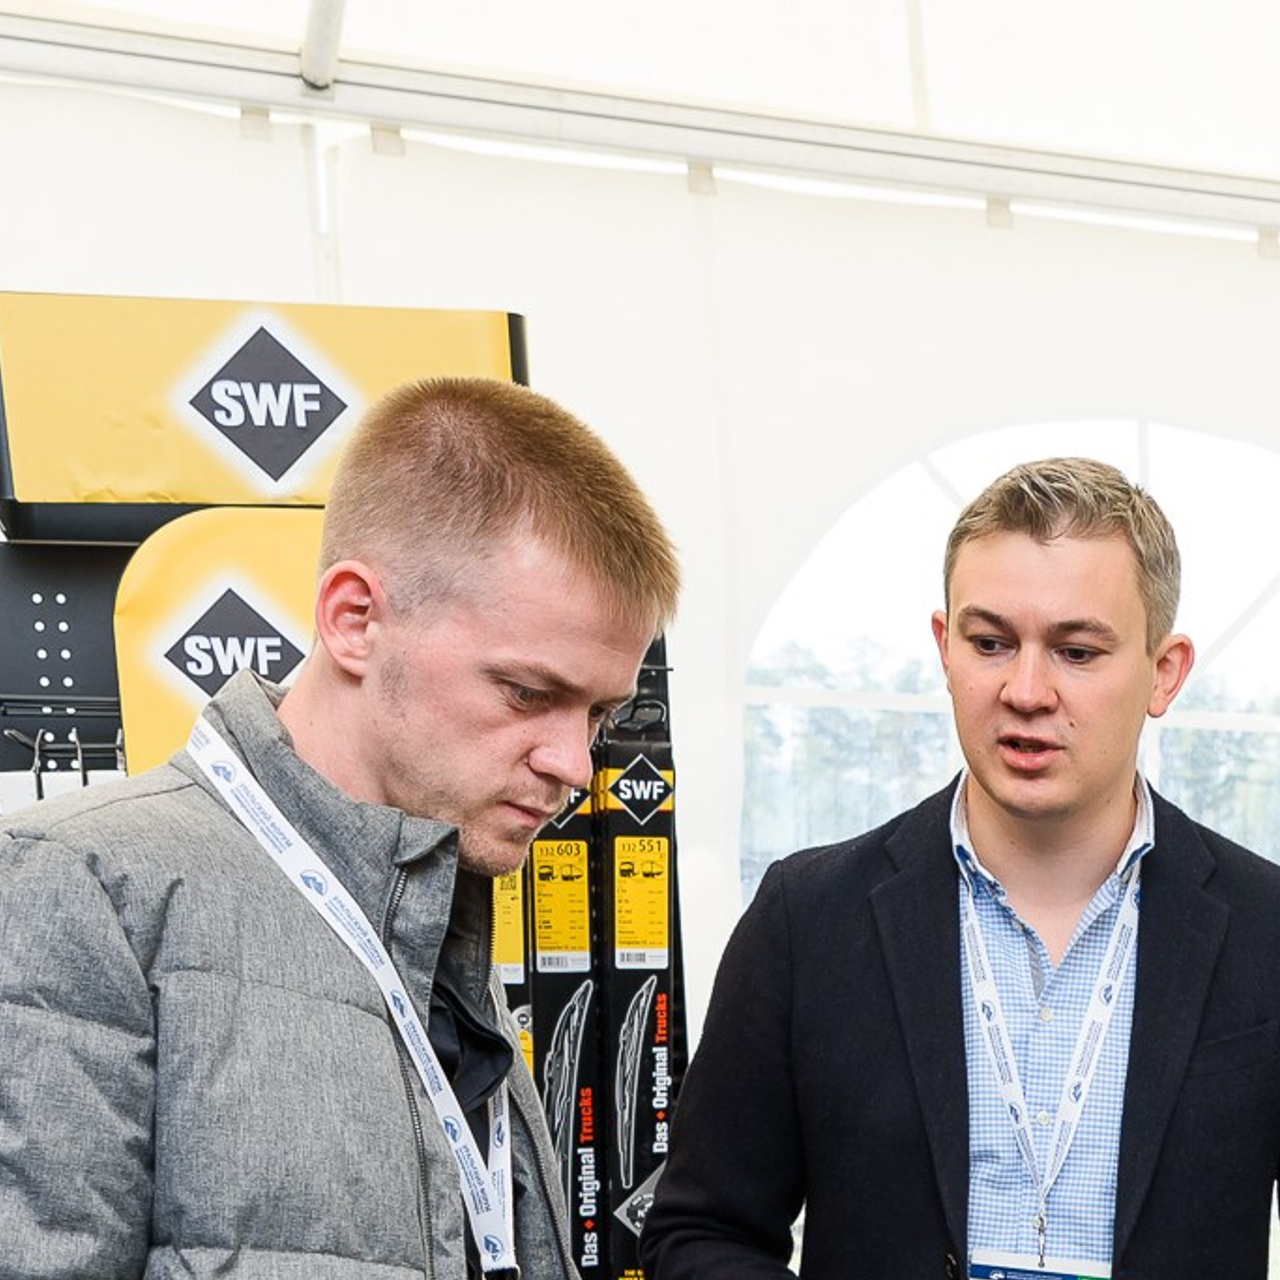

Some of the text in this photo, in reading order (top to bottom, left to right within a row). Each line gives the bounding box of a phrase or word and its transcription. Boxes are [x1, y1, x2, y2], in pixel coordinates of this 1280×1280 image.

[214, 380, 321, 427] SWF
[184, 635, 282, 675] SWF
[619, 779, 665, 801] SWF
[557, 842, 581, 857] 603
[639, 839, 662, 853] 551
[652, 993, 672, 1153] Das Original Trucks
[577, 1087, 600, 1267] Das Original Trucks
